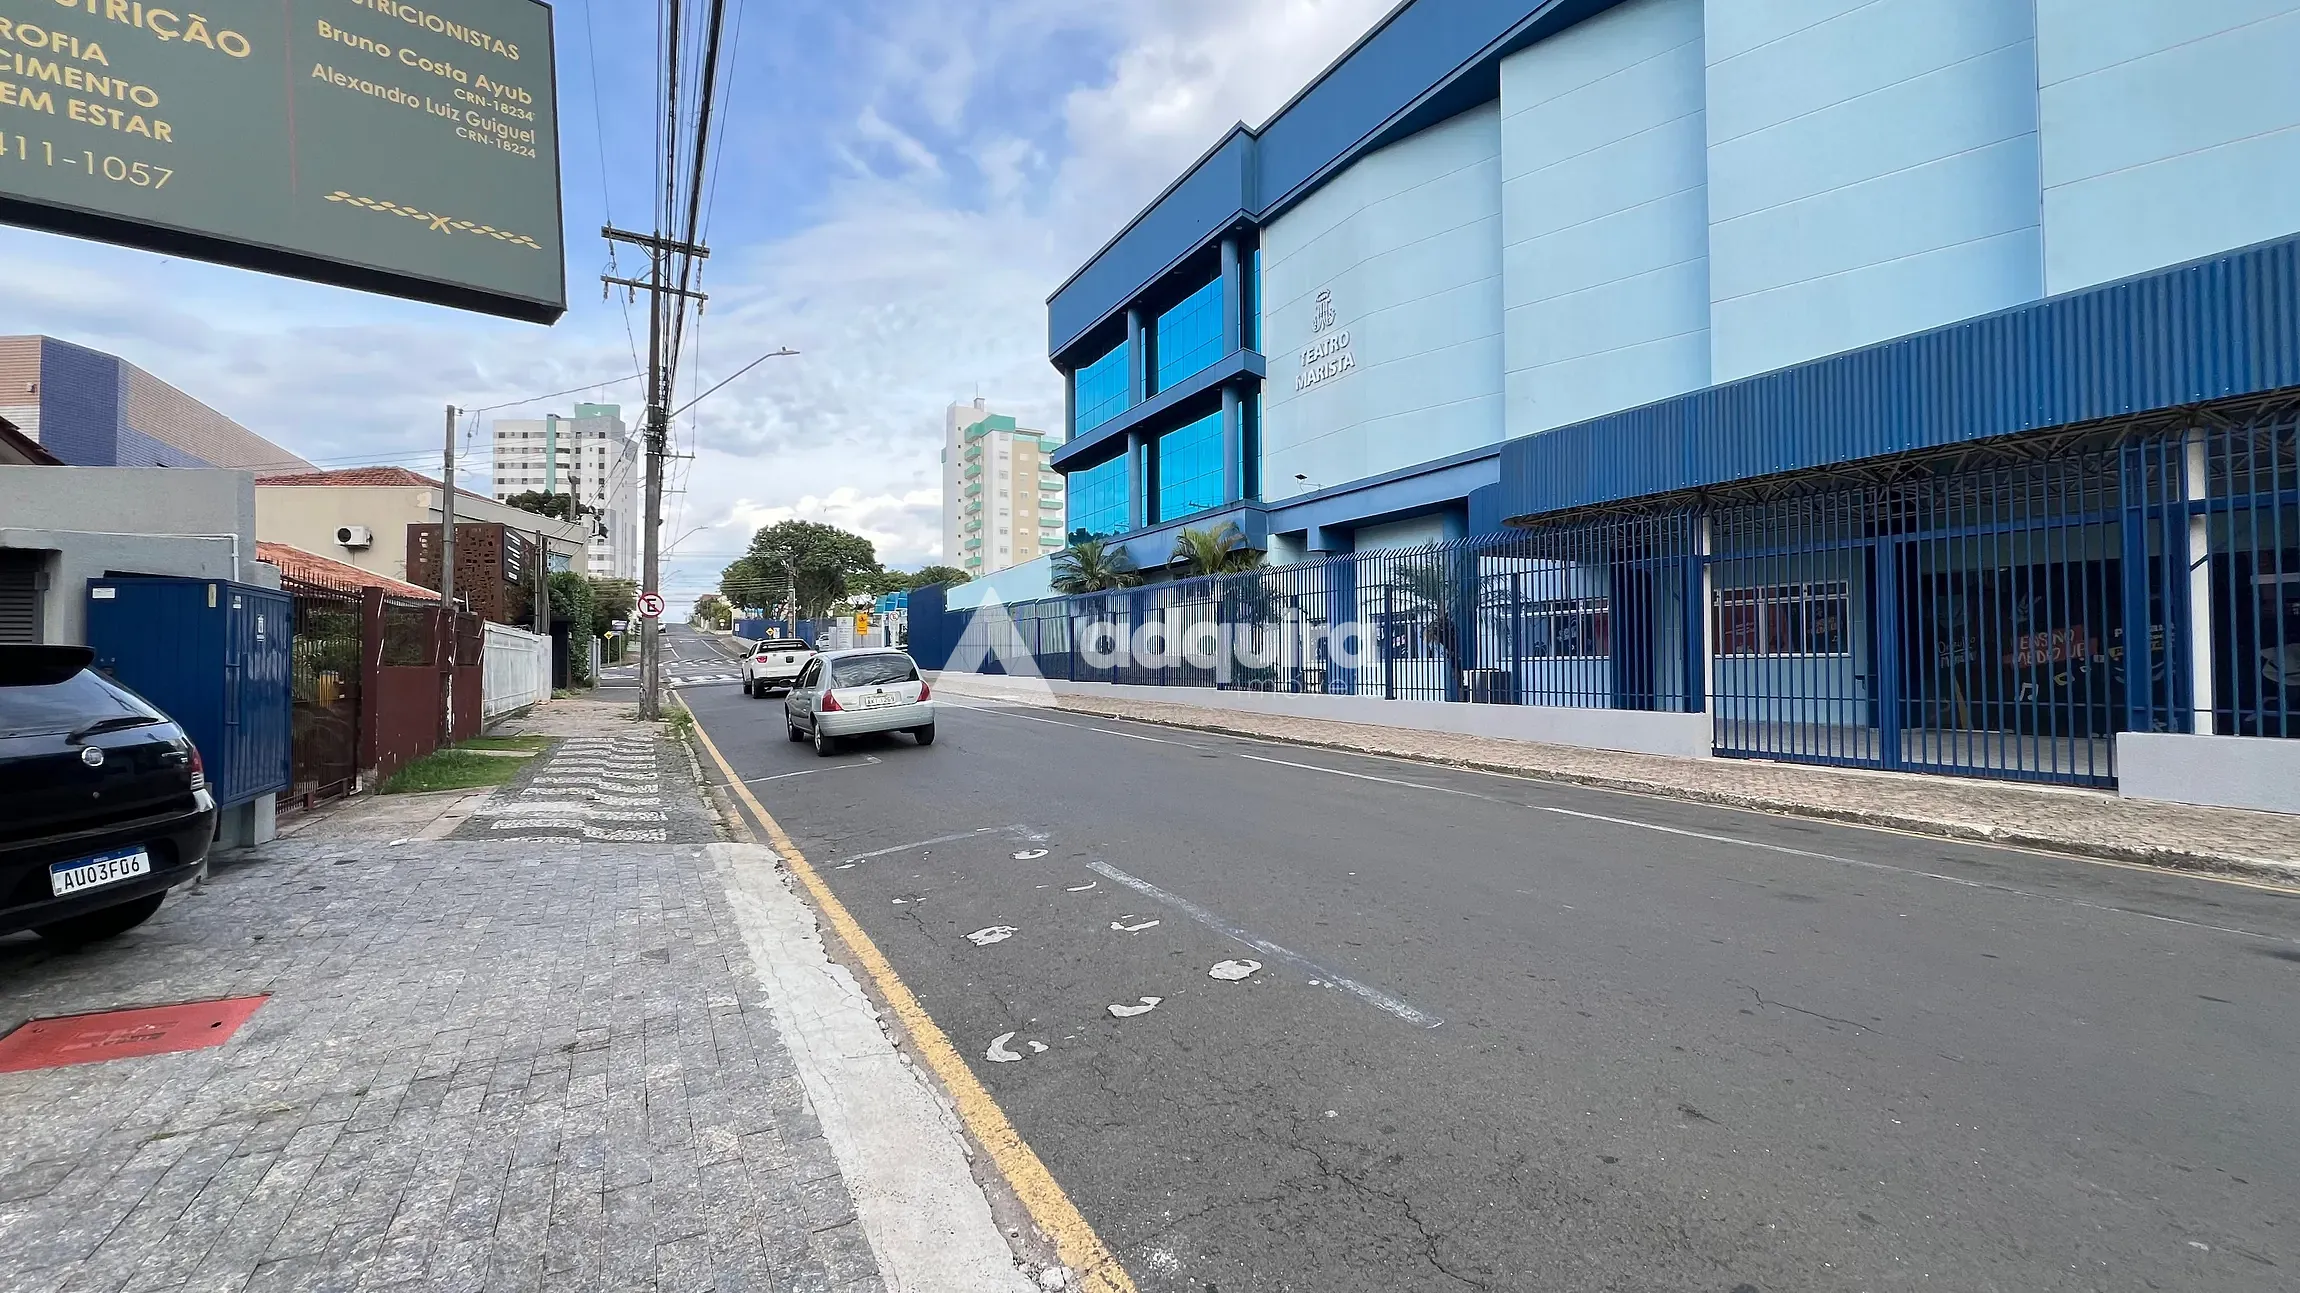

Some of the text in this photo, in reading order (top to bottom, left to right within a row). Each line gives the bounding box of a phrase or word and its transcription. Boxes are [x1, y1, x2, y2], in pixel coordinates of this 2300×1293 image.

[53, 0, 250, 58] TRIÇÃO
[352, 0, 520, 61] TRICIONISTAS
[317, 19, 533, 105] Bruno Costa Ayub
[68, 98, 173, 143] ESTAR
[312, 63, 536, 145] Alexandro Luiz Guiguel
[454, 88, 534, 122] CRN-18234
[455, 127, 536, 159] CRN-18224
[1295, 352, 1356, 391] MARISTA
[1300, 331, 1351, 367] TEATRO
